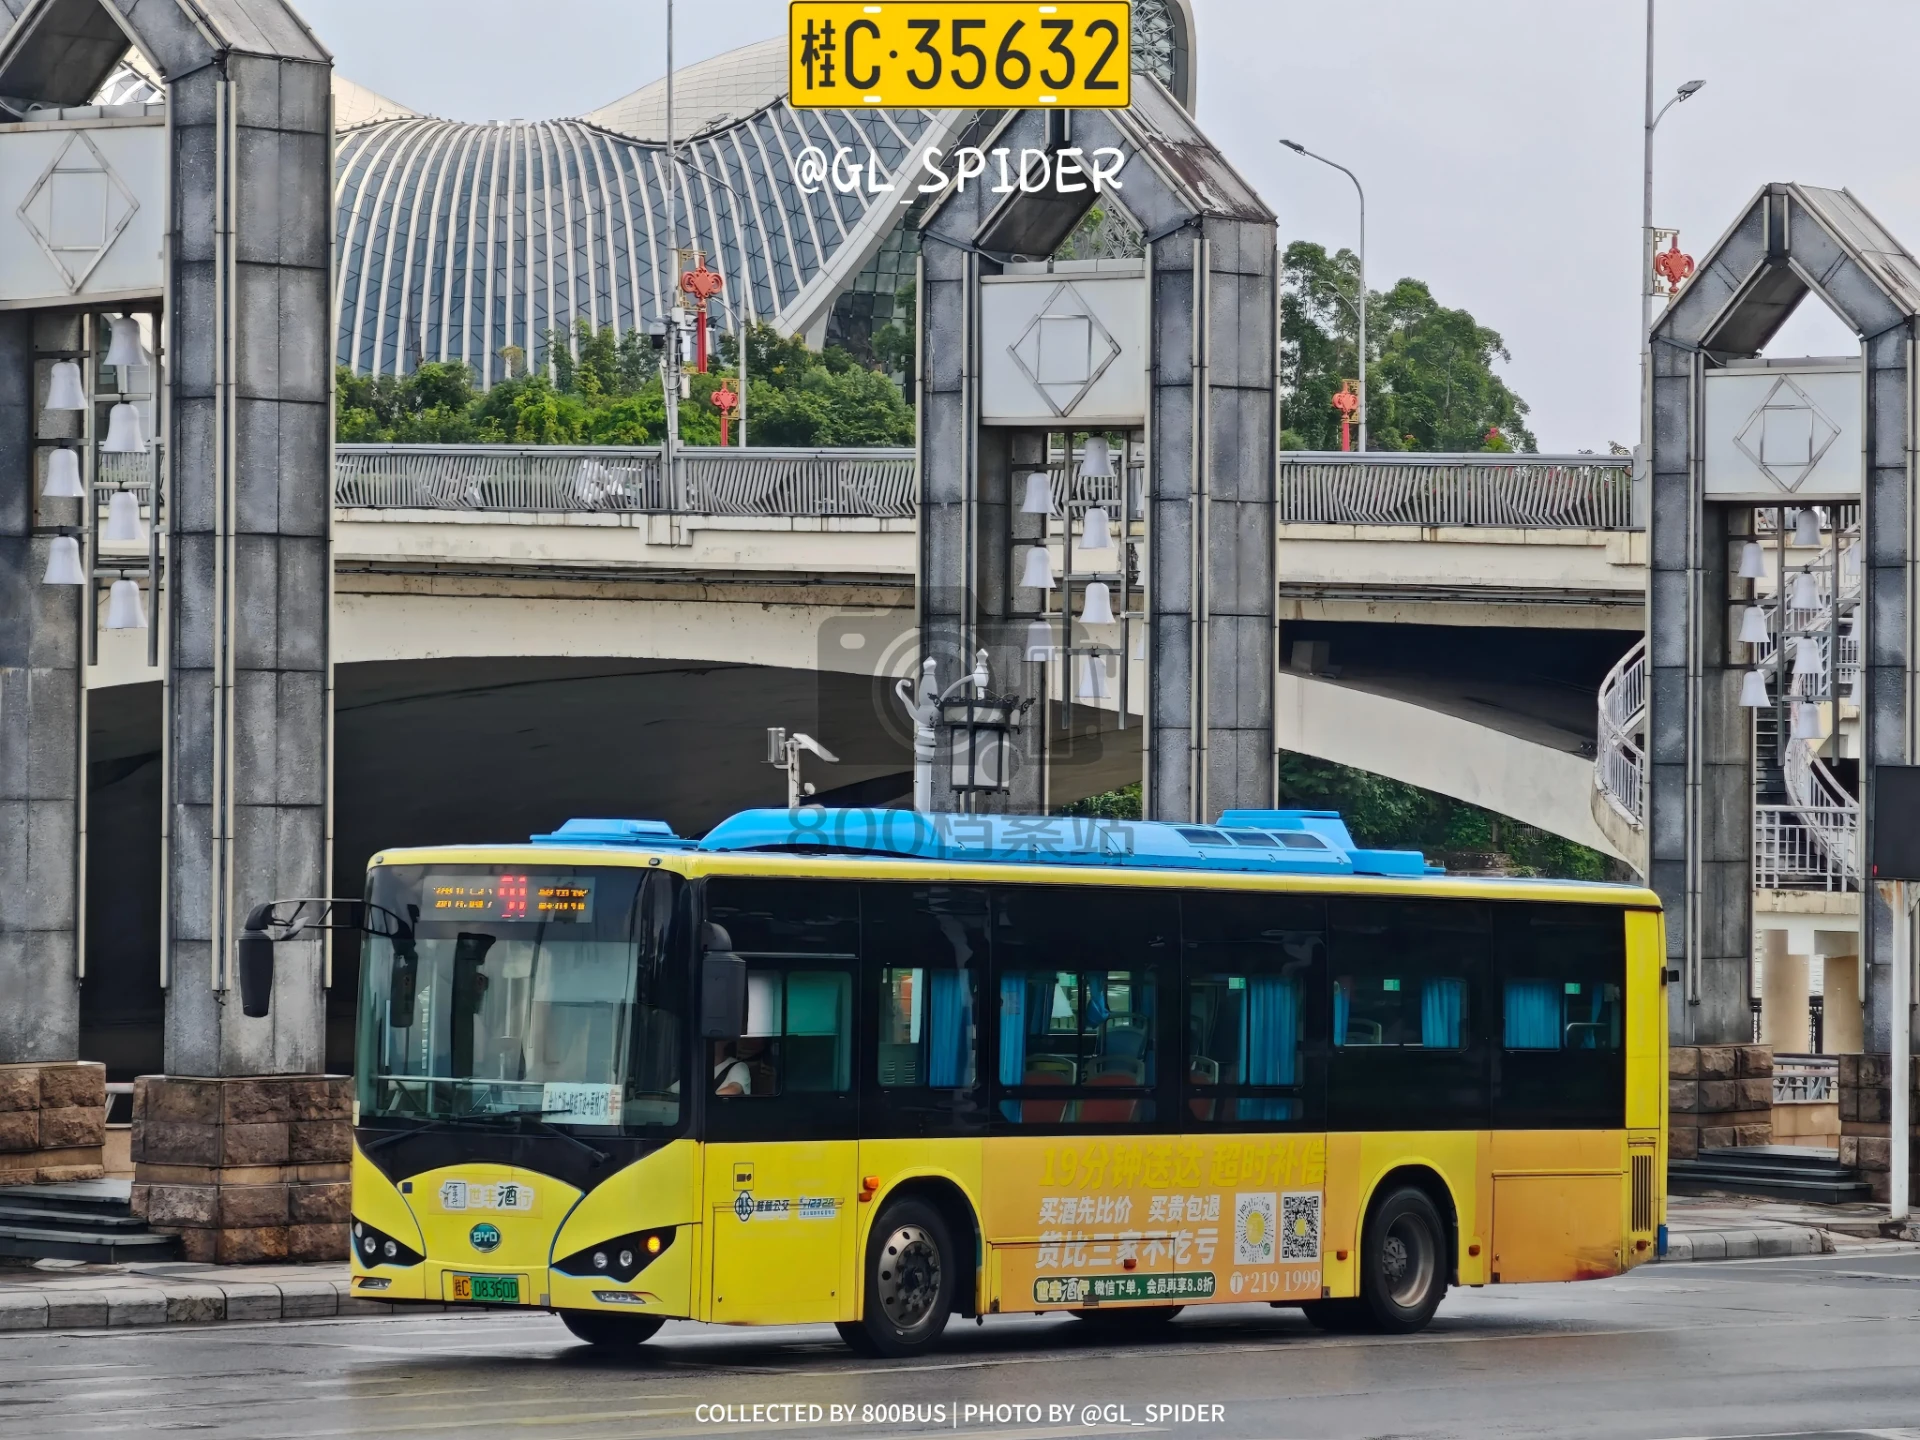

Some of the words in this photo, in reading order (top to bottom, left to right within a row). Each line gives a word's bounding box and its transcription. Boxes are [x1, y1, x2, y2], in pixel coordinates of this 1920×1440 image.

[1039, 1143, 1205, 1190] 19分钟送达
[1208, 1140, 1327, 1187] 超时补偿
[1038, 1195, 1133, 1225] 买酒先比价
[1148, 1194, 1221, 1222] 买贵包退
[473, 1231, 498, 1243] BYD
[1035, 1228, 1219, 1269] 货比三家不吃亏
[1283, 1269, 1321, 1292] 1999
